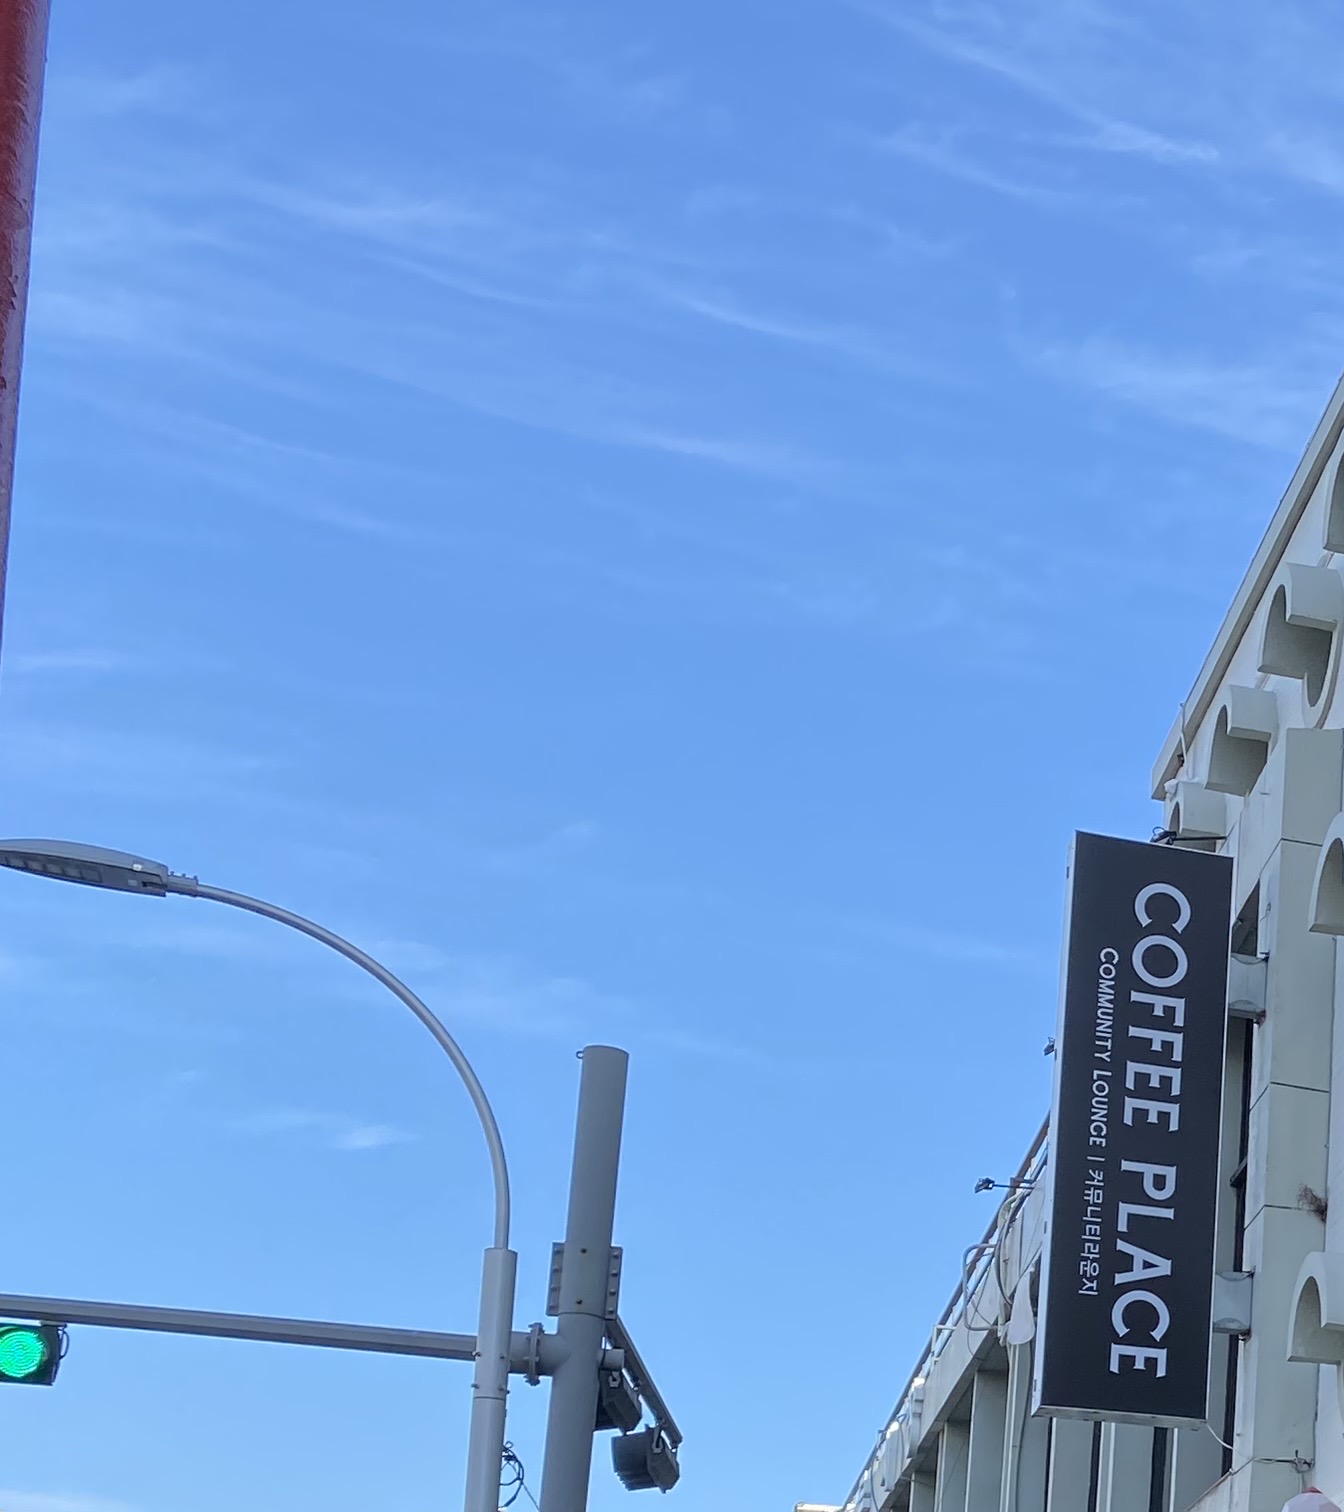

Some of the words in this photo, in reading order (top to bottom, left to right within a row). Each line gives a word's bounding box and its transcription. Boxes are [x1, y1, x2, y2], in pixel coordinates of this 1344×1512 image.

[1094, 947, 1119, 1063] COMMUNITY
[1123, 882, 1193, 1133] COFFEE
[1078, 1167, 1104, 1295] 커뮤니티라운지
[1109, 1158, 1178, 1379] PLACE
